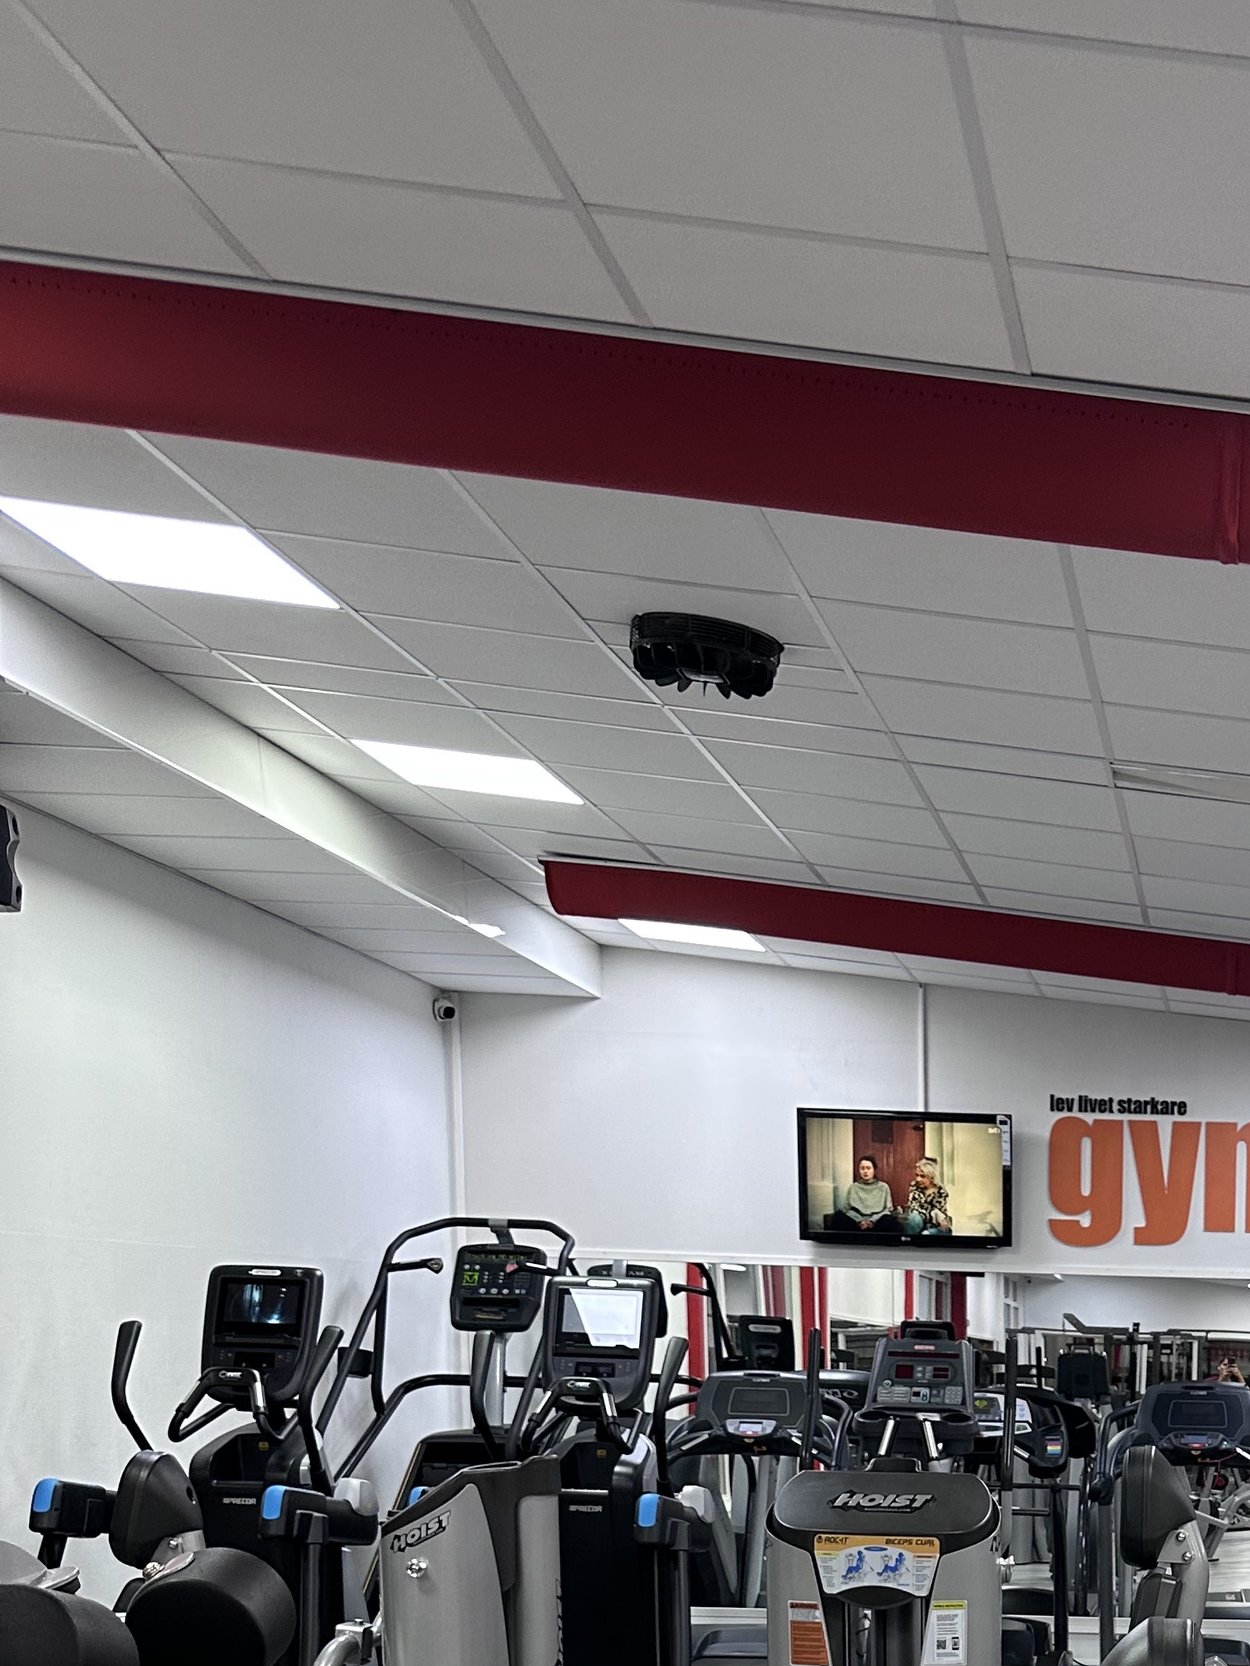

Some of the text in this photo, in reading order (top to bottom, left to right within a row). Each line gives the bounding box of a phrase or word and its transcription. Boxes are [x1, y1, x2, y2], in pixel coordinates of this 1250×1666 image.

[1050, 1094, 1187, 1116] lev livet starkare
[833, 1493, 933, 1508] HOIST
[392, 1513, 450, 1552] HOIST
